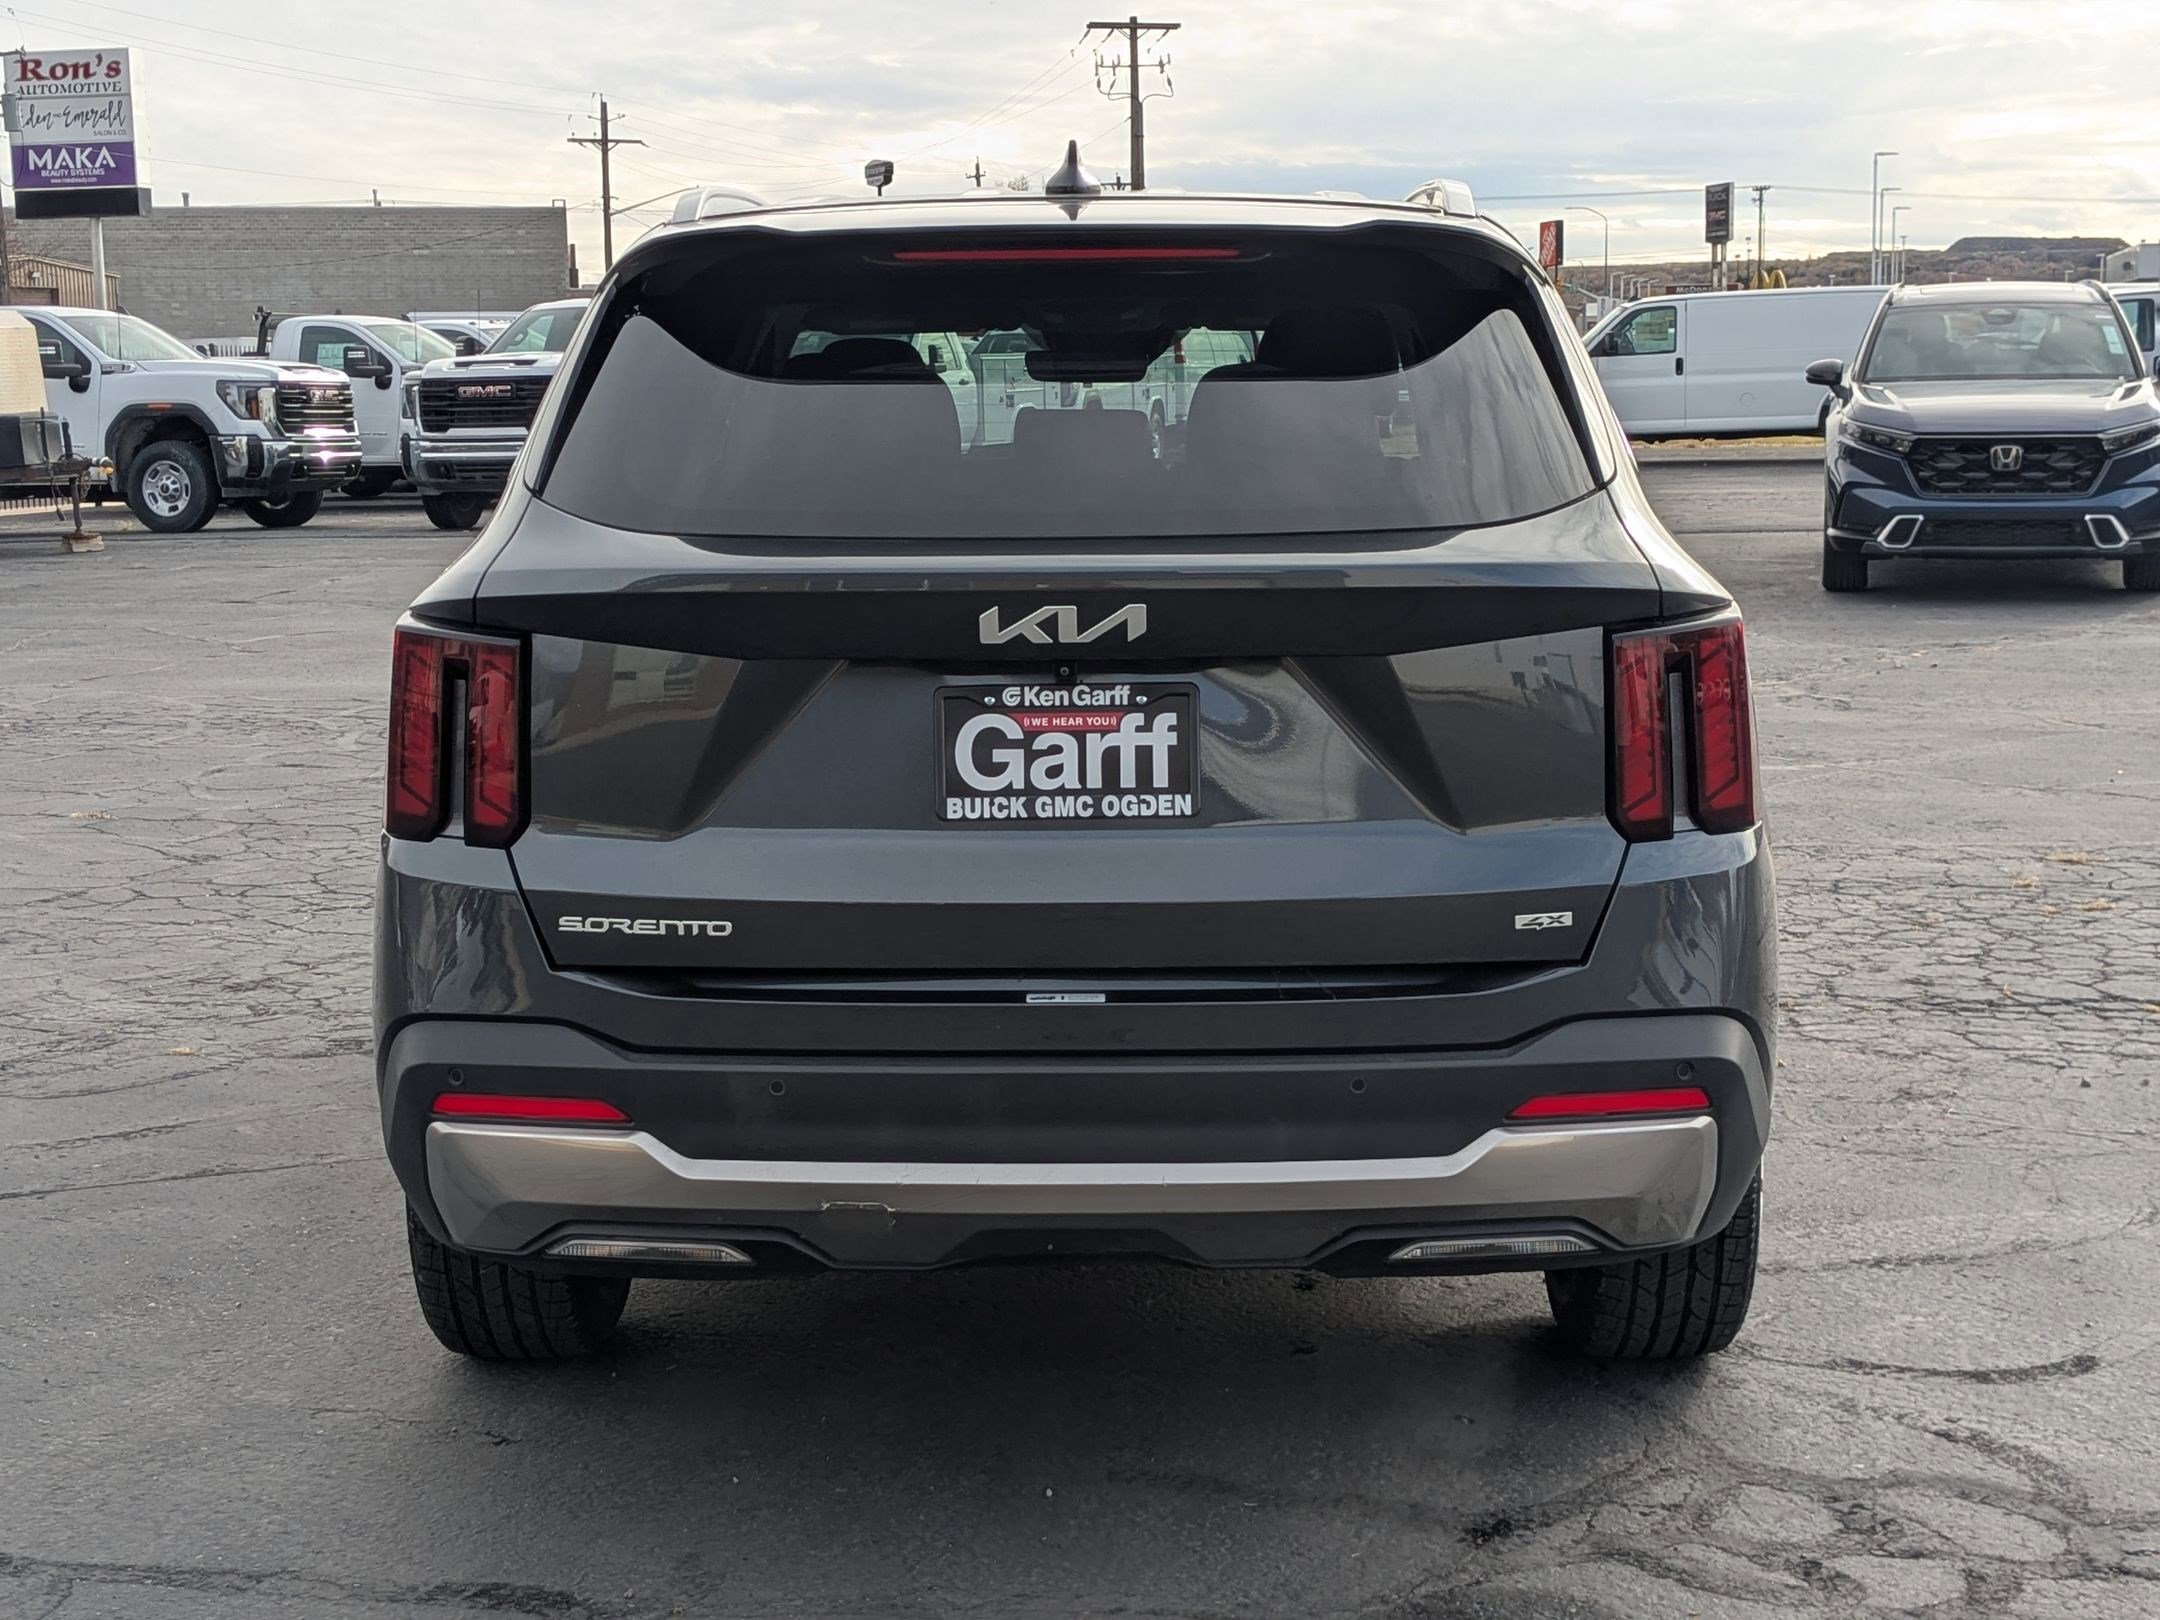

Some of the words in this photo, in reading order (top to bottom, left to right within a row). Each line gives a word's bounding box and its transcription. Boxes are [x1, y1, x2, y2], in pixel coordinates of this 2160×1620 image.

[14, 53, 122, 82] Ron's
[16, 82, 122, 96] AUTOMOTIVE
[22, 104, 55, 130] den
[28, 146, 116, 170] MAKA
[41, 169, 68, 177] BEAUTY
[70, 168, 105, 176] SYSTEMS
[458, 385, 511, 398] GMC
[979, 603, 1147, 644] KIA
[1024, 685, 1069, 706] Ken
[1072, 685, 1130, 706] Garff
[1031, 717, 1049, 726] WE
[1053, 717, 1083, 726] HEAR
[1087, 717, 1109, 726] YOU
[954, 712, 1178, 791] Garff
[947, 797, 1028, 819] BUICK
[1035, 796, 1094, 818] GMC
[1101, 794, 1192, 817] OGDEN
[557, 916, 733, 937] SORENTO
